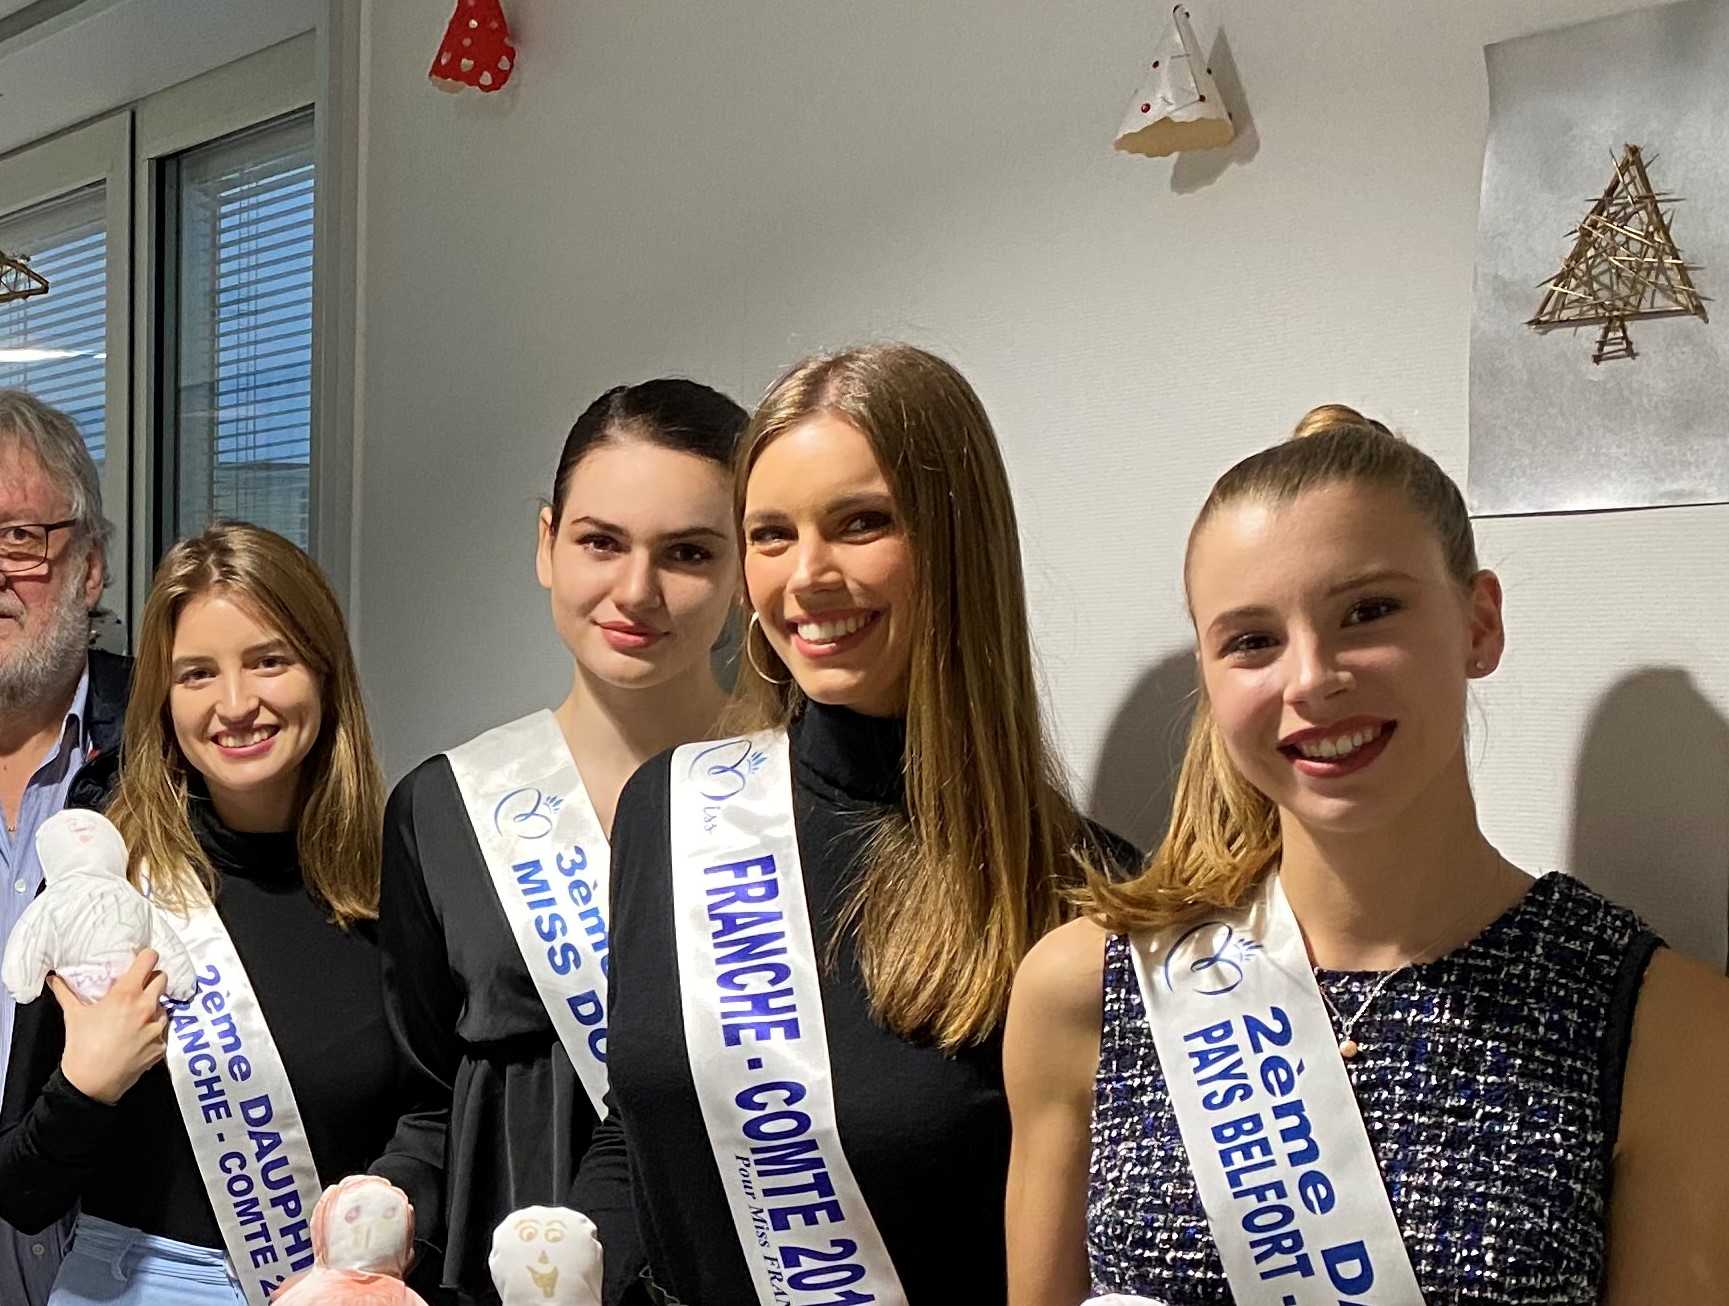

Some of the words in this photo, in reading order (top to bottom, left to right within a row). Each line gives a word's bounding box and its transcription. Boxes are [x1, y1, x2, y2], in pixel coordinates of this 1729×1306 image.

[512, 858, 582, 977] MISS
[703, 853, 801, 1048] FRANCHE
[196, 964, 252, 1082] 2ème
[1183, 1018, 1253, 1111] PAYS
[734, 1080, 845, 1234] COMTE
[1240, 1005, 1337, 1216] 2ème
[218, 1151, 279, 1270] COMTE
[734, 1153, 757, 1200] Pour
[746, 1204, 771, 1249] Miss
[1211, 1111, 1315, 1284] BELFORT
